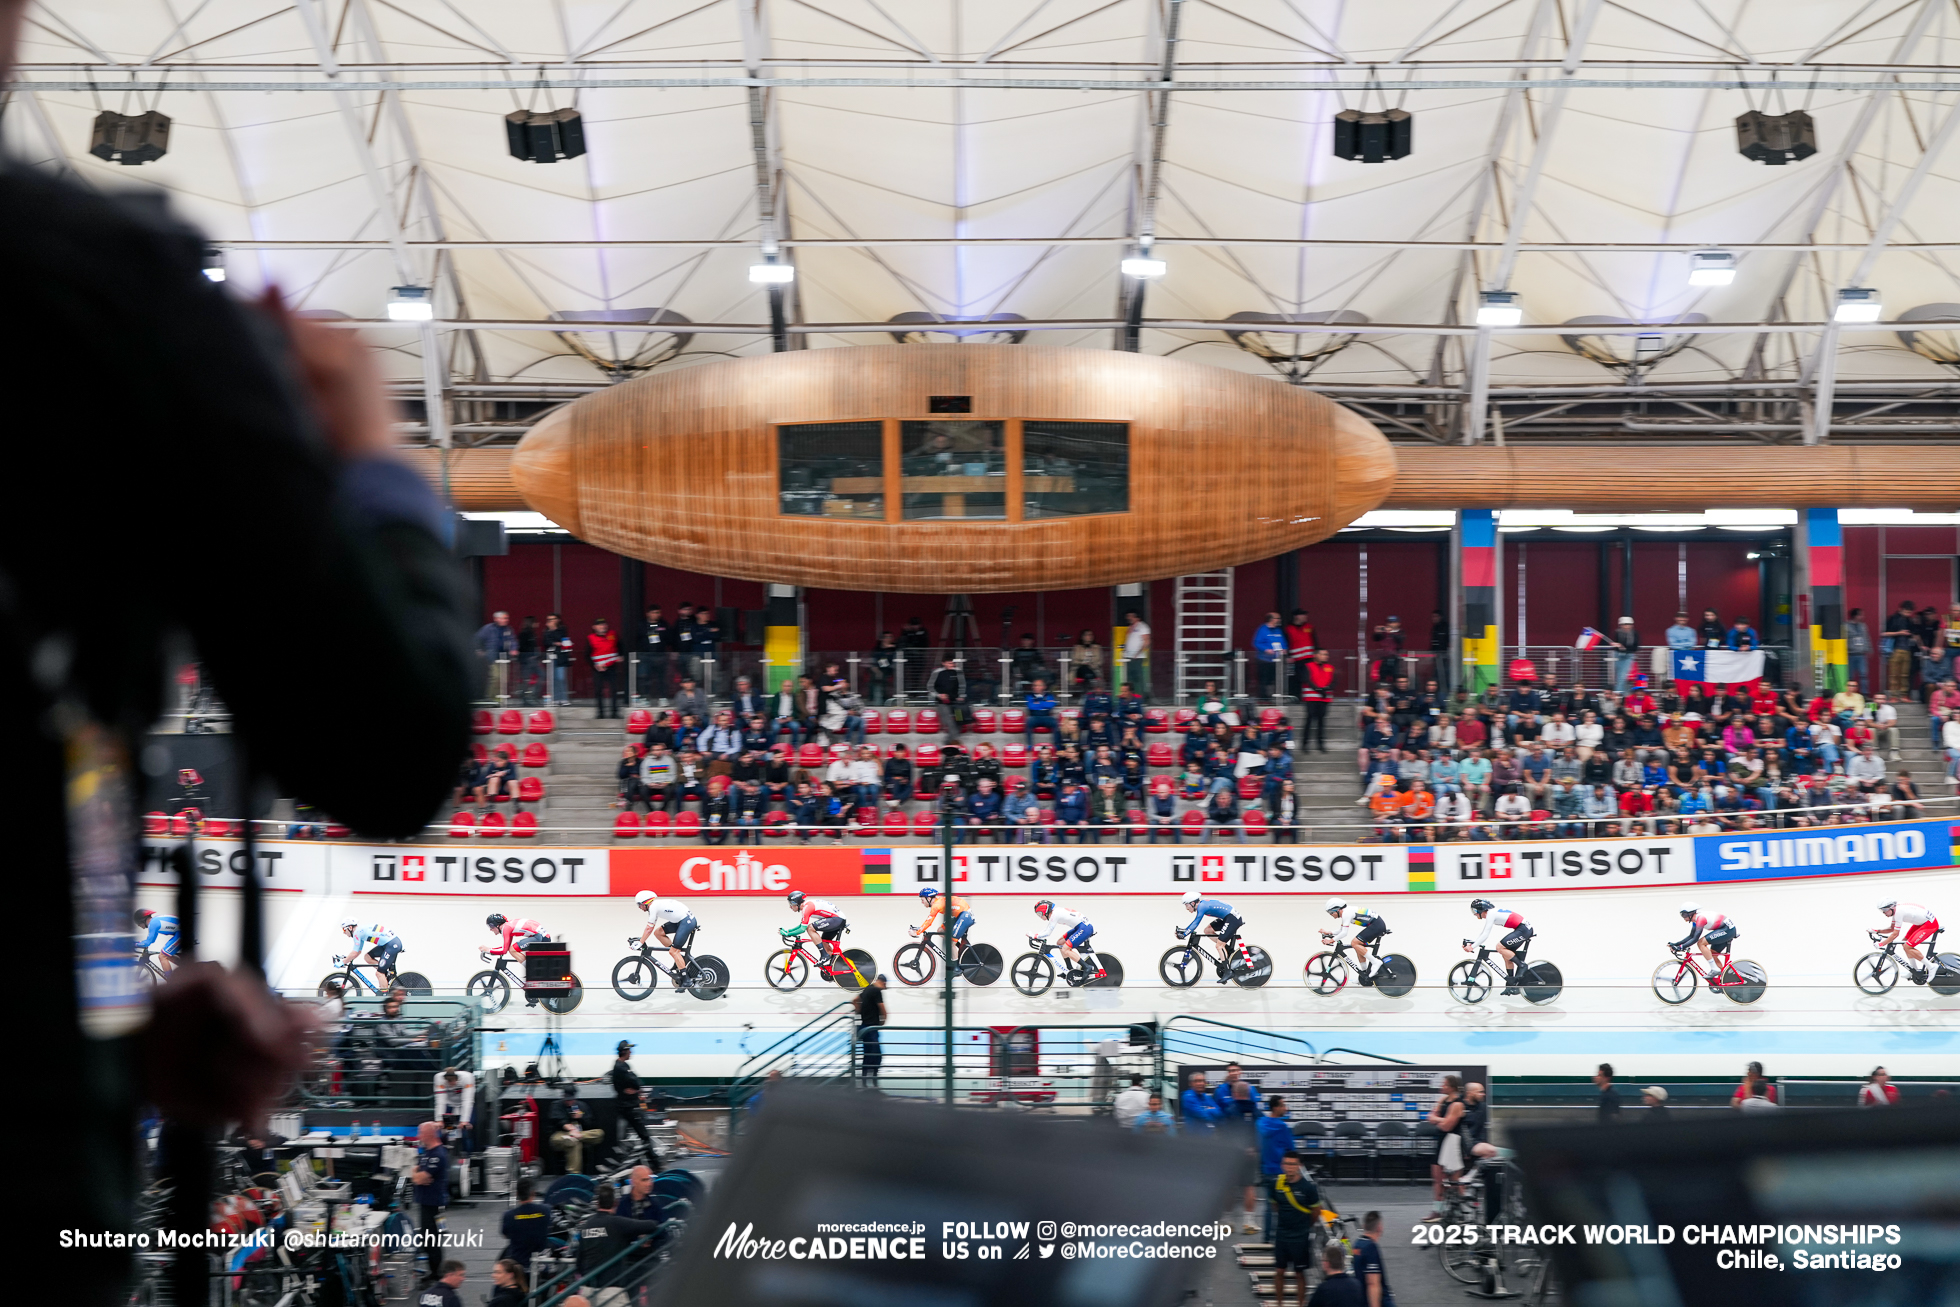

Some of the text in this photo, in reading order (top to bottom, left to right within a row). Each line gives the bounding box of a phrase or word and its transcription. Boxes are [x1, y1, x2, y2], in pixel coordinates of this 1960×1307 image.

[1521, 848, 1671, 877] TISSOT
[1719, 830, 1926, 871] SHIMANO
[435, 857, 584, 884] TISSOT
[679, 850, 792, 891] Chile
[978, 856, 1127, 883] TISSOT
[1234, 855, 1383, 882] TISSOT
[1071, 929, 1085, 942] JAPAN
[1220, 922, 1230, 935] USA
[1506, 935, 1526, 946] CHILE
